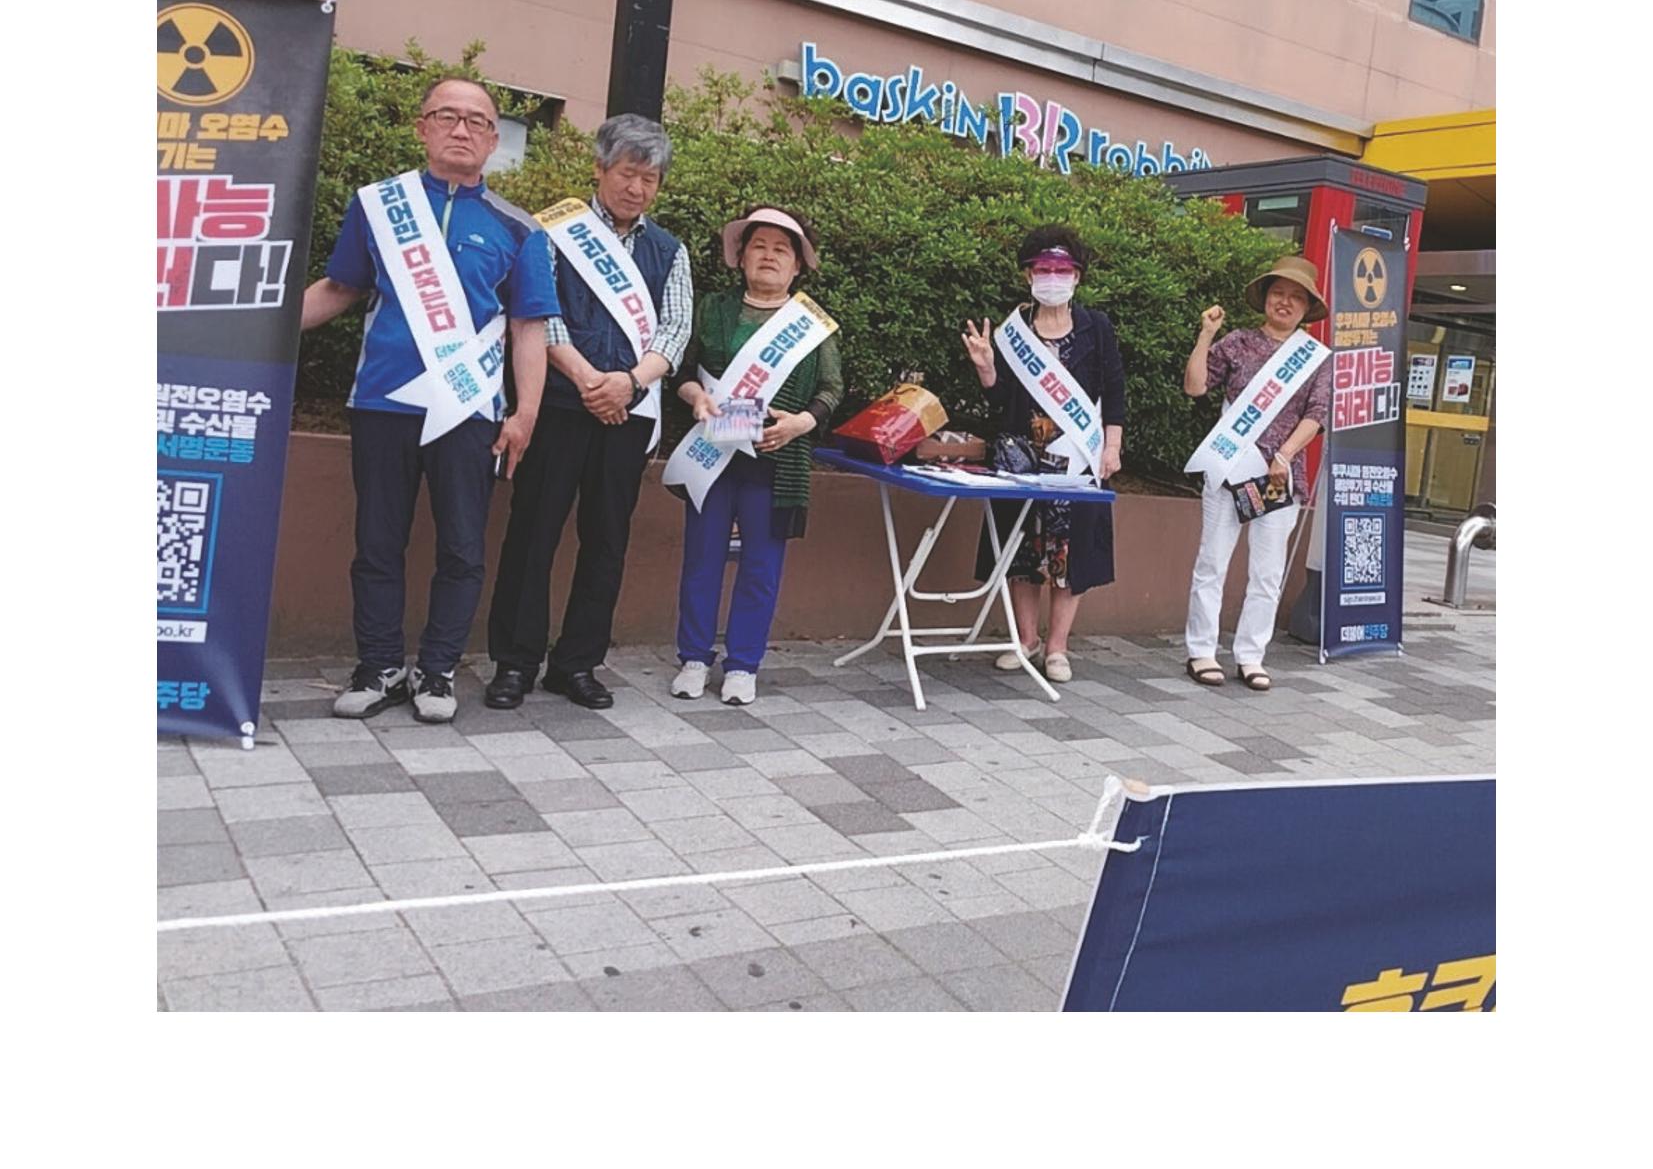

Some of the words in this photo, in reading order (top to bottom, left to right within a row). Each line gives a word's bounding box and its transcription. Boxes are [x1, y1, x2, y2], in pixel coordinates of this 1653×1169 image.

[197, 112, 289, 142] 오염수
[1333, 347, 1394, 392] 방사능
[1039, 371, 1092, 432] 반대한다
[1332, 383, 1400, 431] 테러다!
[179, 412, 257, 439] 수산물
[157, 433, 254, 463] 서명운동
